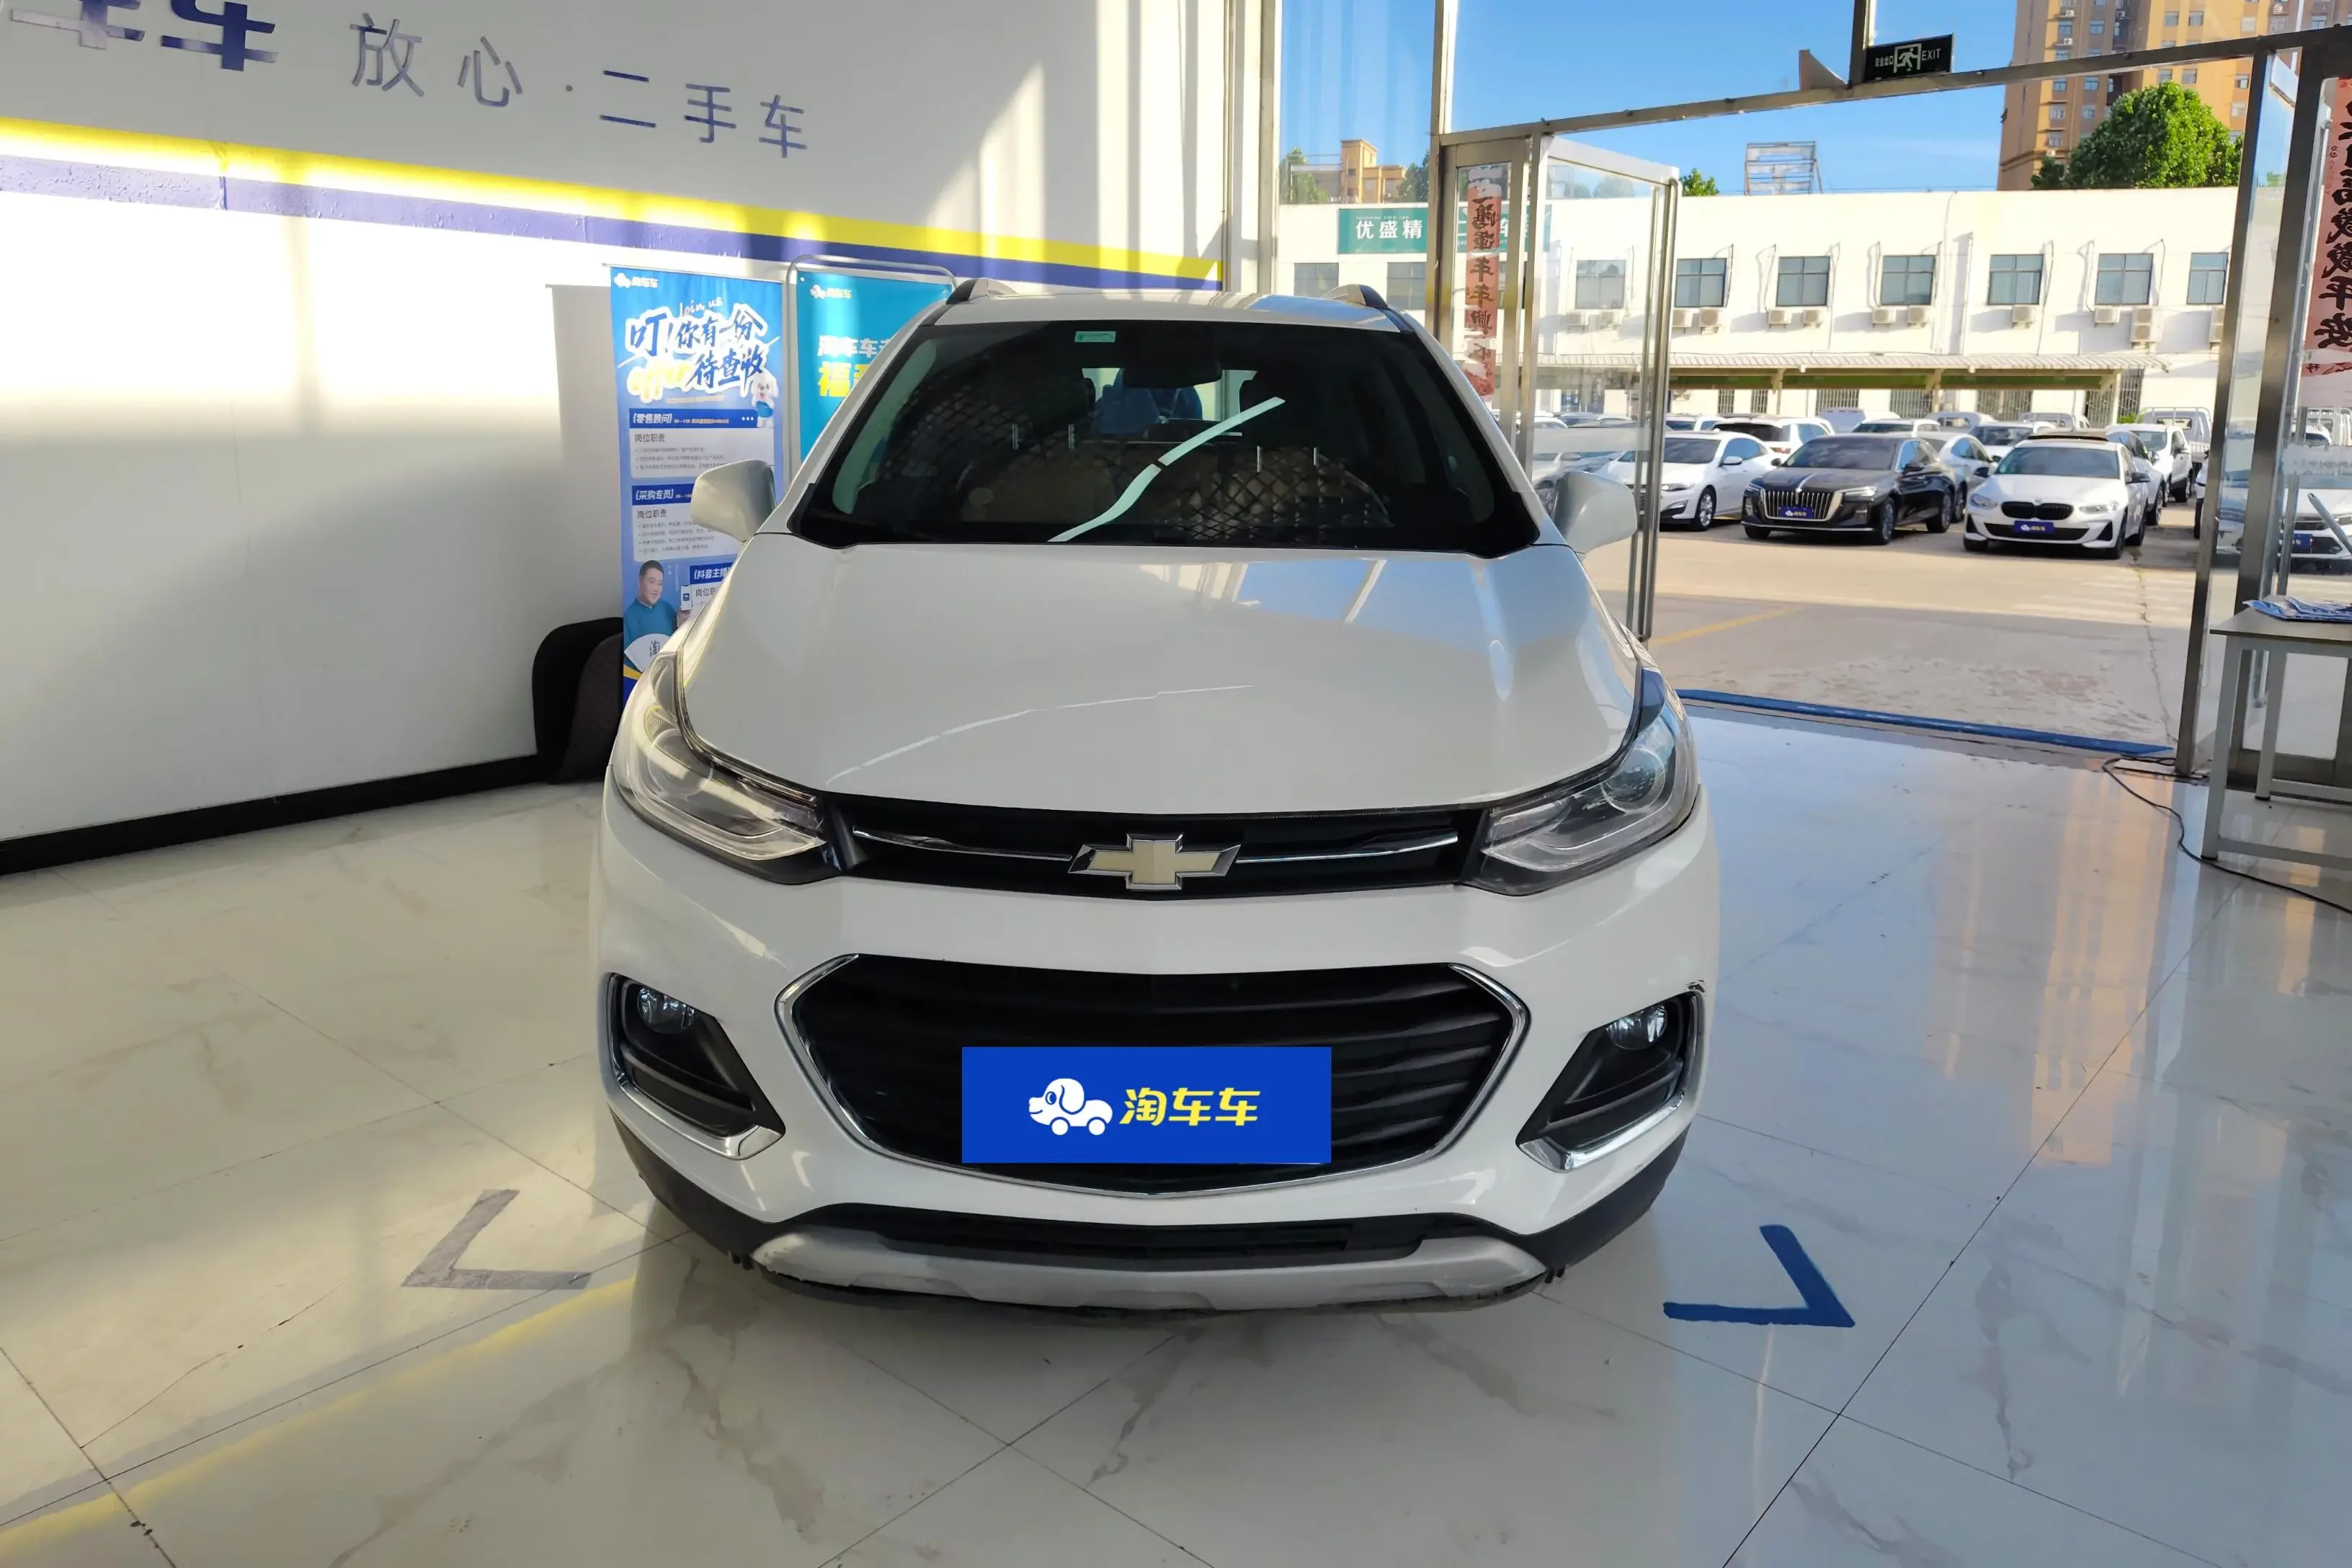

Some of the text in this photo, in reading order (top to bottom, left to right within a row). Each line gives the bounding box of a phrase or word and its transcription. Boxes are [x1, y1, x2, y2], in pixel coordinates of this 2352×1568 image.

[1922, 48, 1941, 61] EXIT
[685, 344, 765, 393] 待查收
[637, 509, 667, 519] 岗位职责
